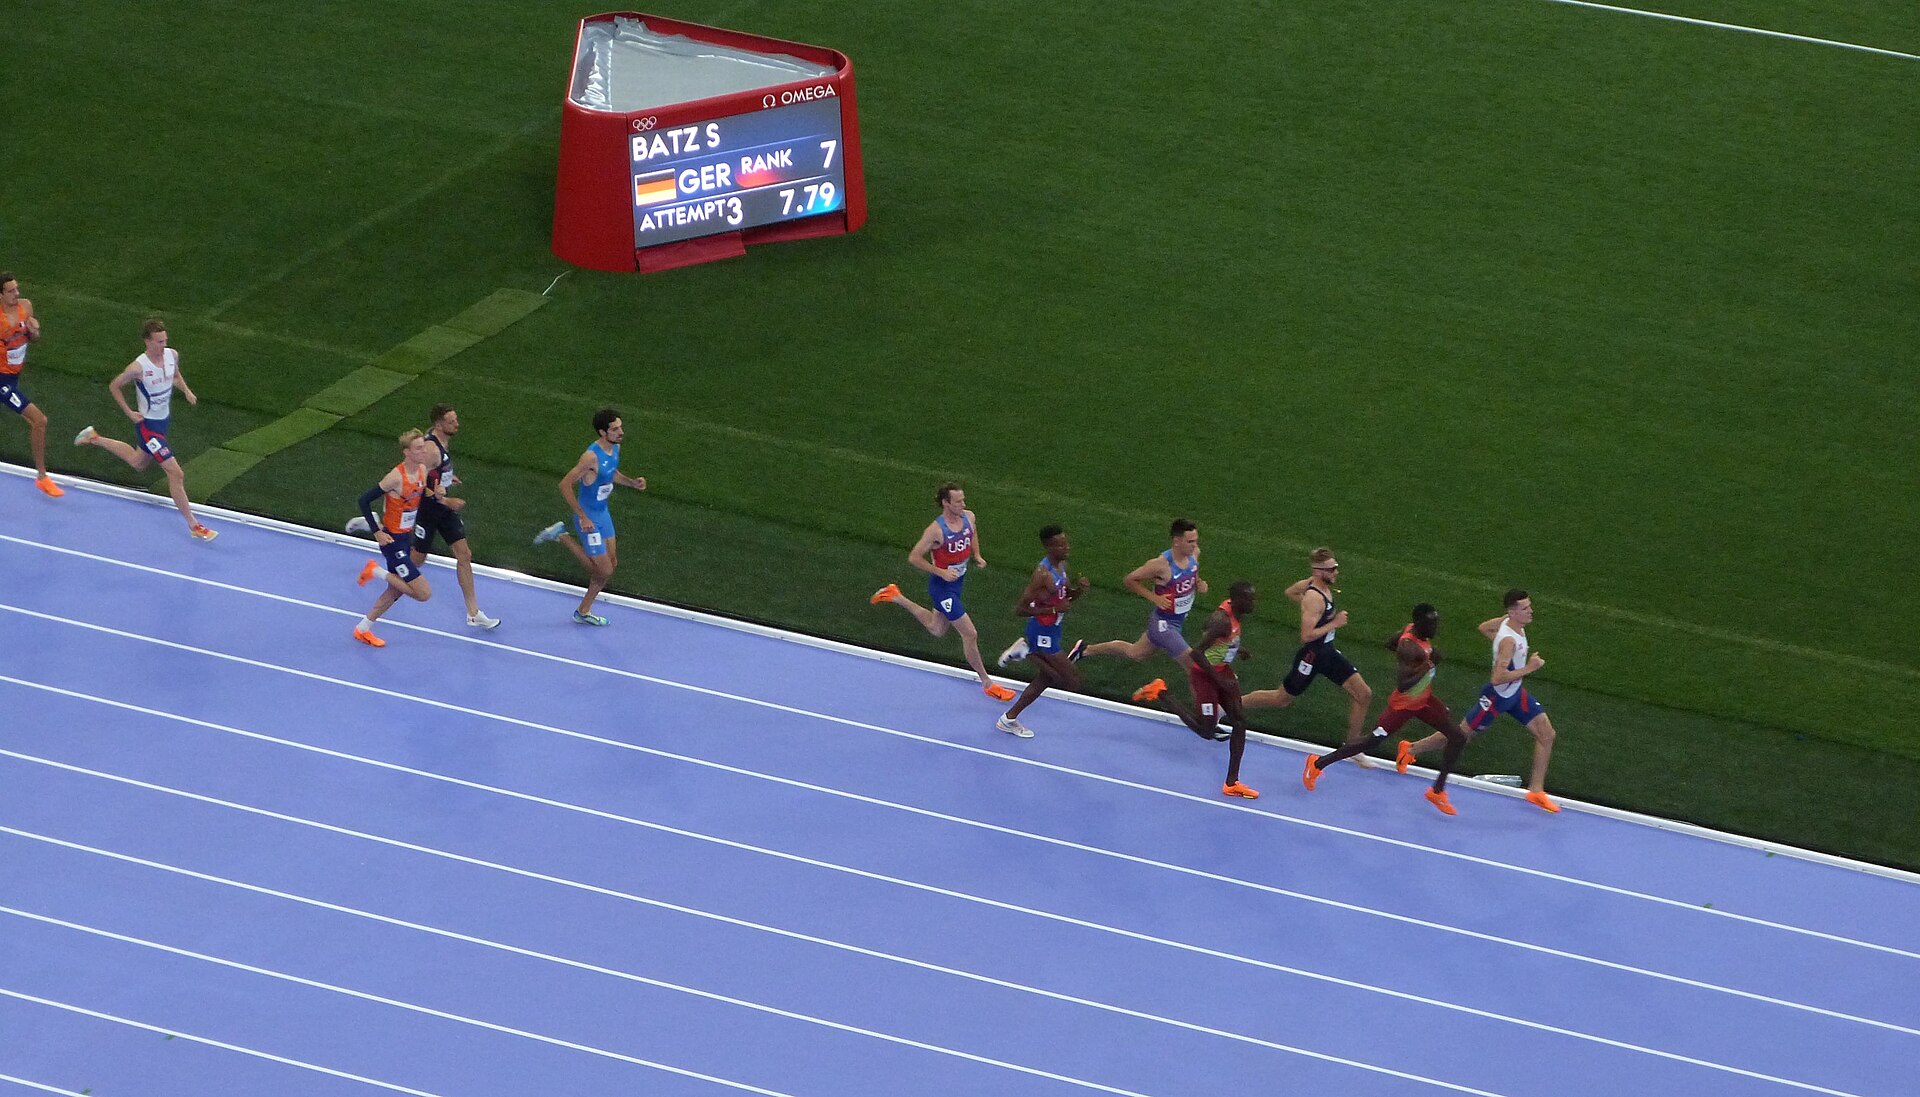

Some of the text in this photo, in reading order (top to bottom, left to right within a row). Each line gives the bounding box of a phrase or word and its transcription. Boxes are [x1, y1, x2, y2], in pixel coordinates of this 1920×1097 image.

[781, 84, 836, 105] OMEGA
[632, 122, 721, 162] BATZ S
[740, 140, 837, 175] RANK 7
[678, 163, 731, 194] GER
[640, 197, 743, 232] ATTEMPT 3
[779, 181, 836, 216] 7.79
[948, 537, 971, 553] USA
